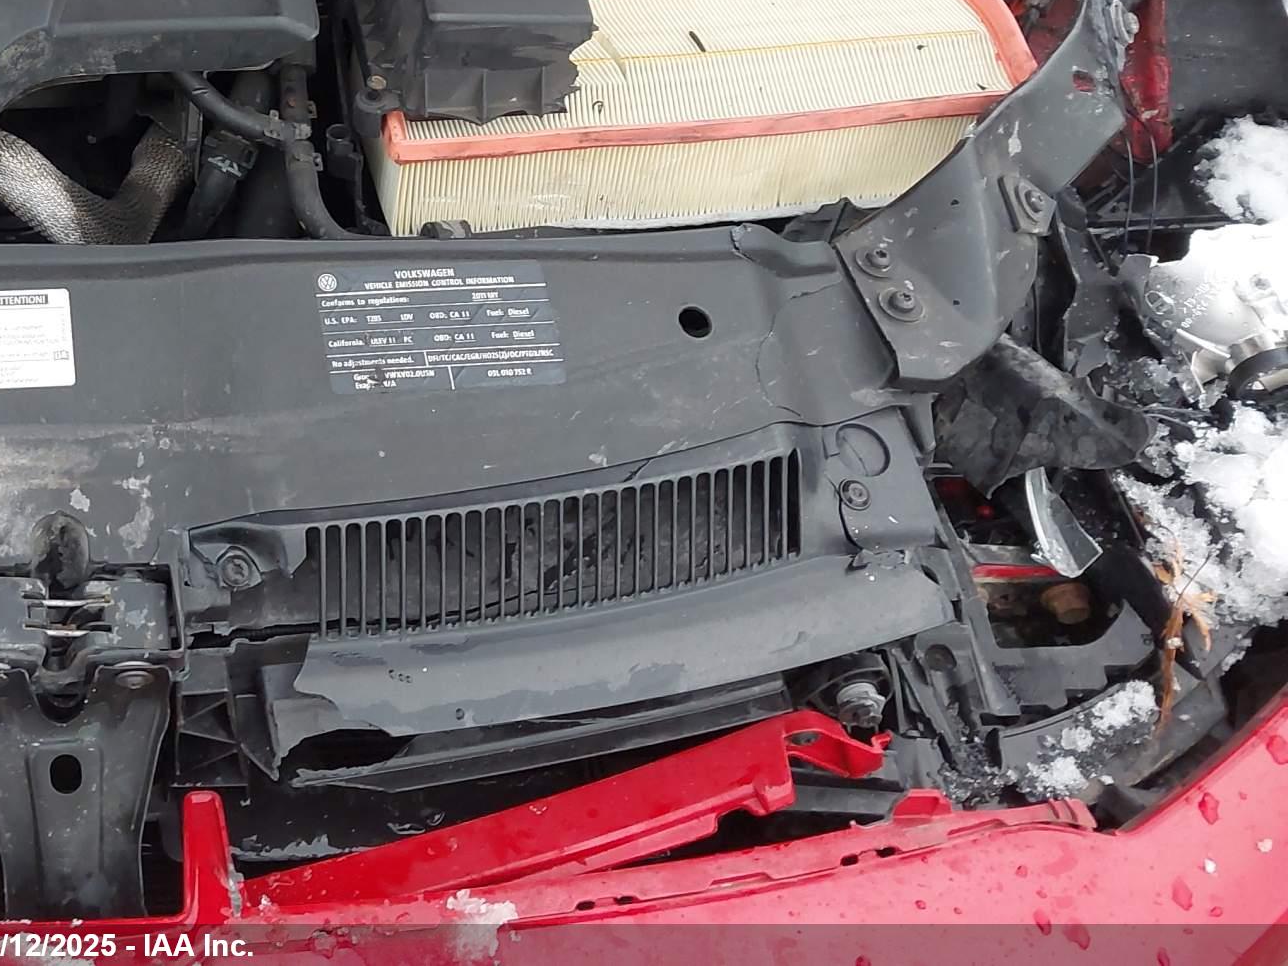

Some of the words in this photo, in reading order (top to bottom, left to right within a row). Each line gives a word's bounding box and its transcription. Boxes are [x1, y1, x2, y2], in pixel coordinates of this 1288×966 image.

[394, 268, 454, 279] VOLKSWAGEN
[364, 281, 393, 290] VEHICLE
[395, 280, 429, 288] EMISSION
[431, 278, 464, 287] CONTROL
[466, 276, 515, 284] INFORMATION
[321, 298, 355, 307] Conforms
[368, 296, 410, 305] regulations:
[450, 310, 460, 318] CA
[487, 308, 504, 316] Fuel:
[513, 330, 534, 338] Diesel
[387, 355, 414, 364] needed.
